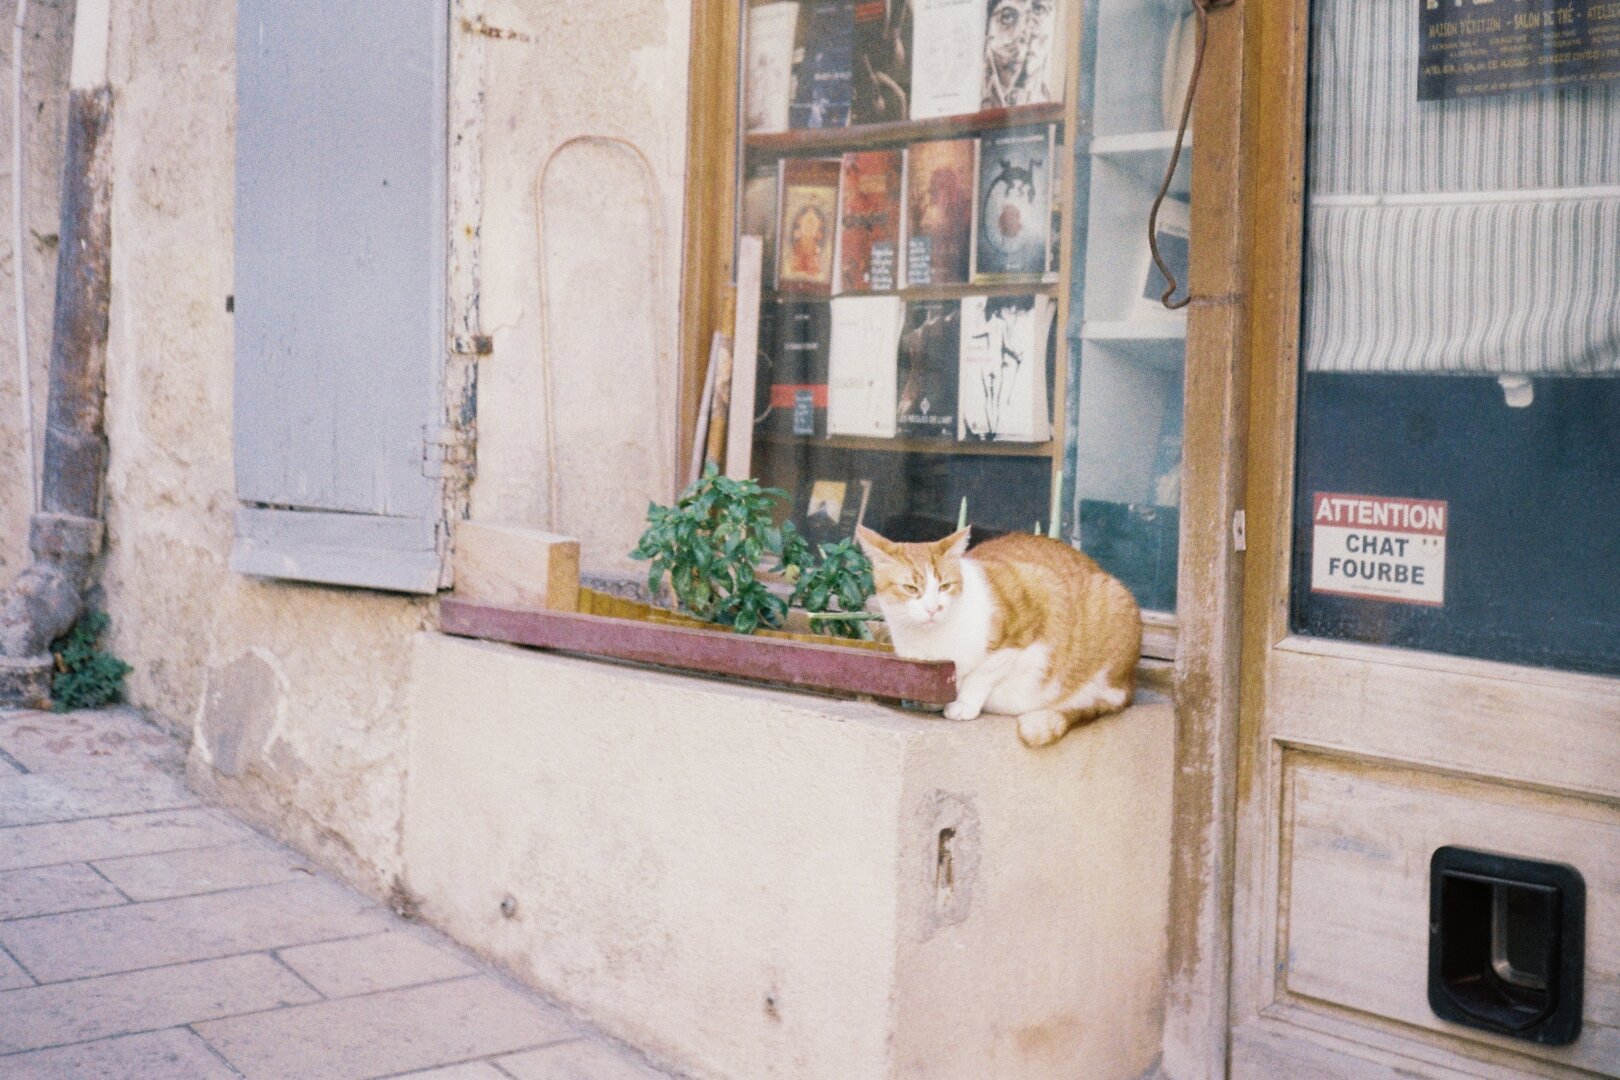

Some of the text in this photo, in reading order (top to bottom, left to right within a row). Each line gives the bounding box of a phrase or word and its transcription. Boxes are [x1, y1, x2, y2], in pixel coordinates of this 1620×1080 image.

[1429, 22, 1457, 38] MAISON
[1515, 12, 1540, 30] SALON
[1316, 497, 1444, 530] ATTENTION
[1346, 534, 1409, 557] CHAT
[1329, 557, 1425, 586] FOURBE
